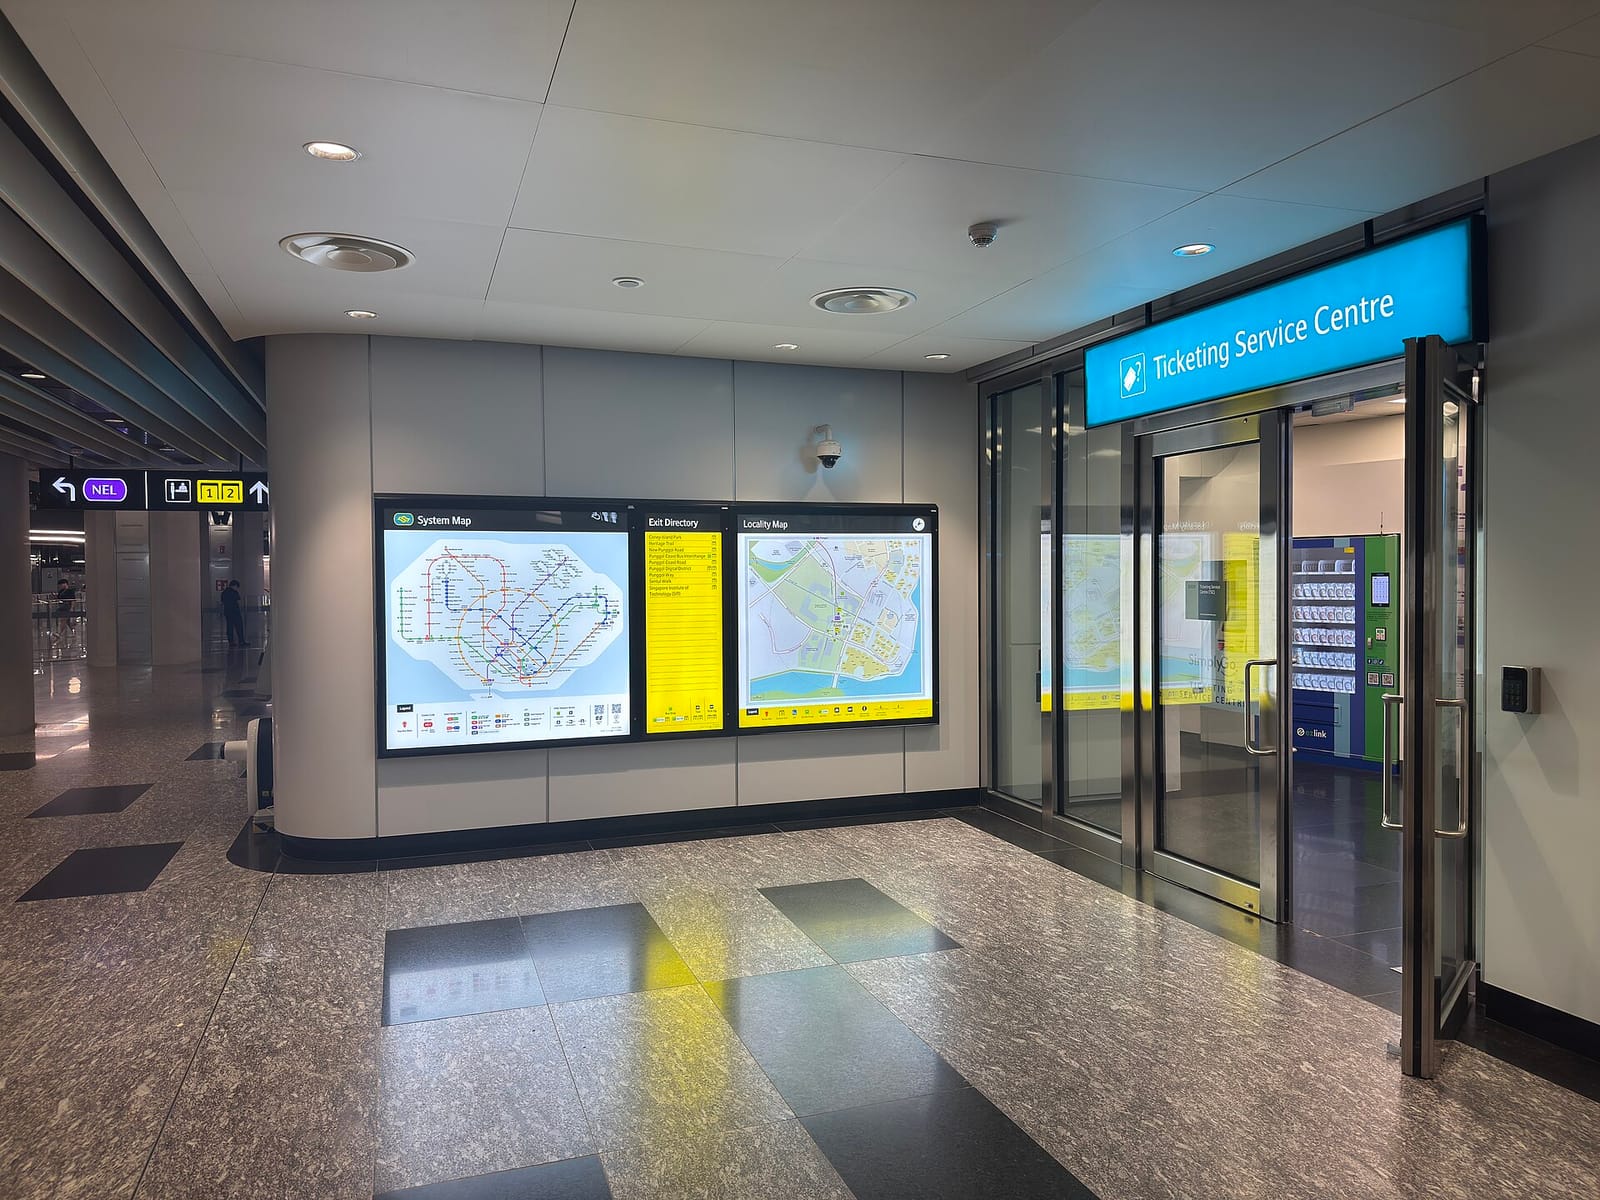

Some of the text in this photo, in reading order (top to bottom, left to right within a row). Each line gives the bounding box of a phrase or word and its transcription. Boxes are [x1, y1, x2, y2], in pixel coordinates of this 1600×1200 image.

[1153, 294, 1394, 380] Ticketing Service Centre
[92, 484, 117, 496] NEL
[207, 488, 234, 499] 1 2
[417, 515, 472, 528] System Map
[648, 517, 699, 529] Exit Directory
[743, 519, 789, 531] Locality Map
[1179, 689, 1211, 702] SERVICE
